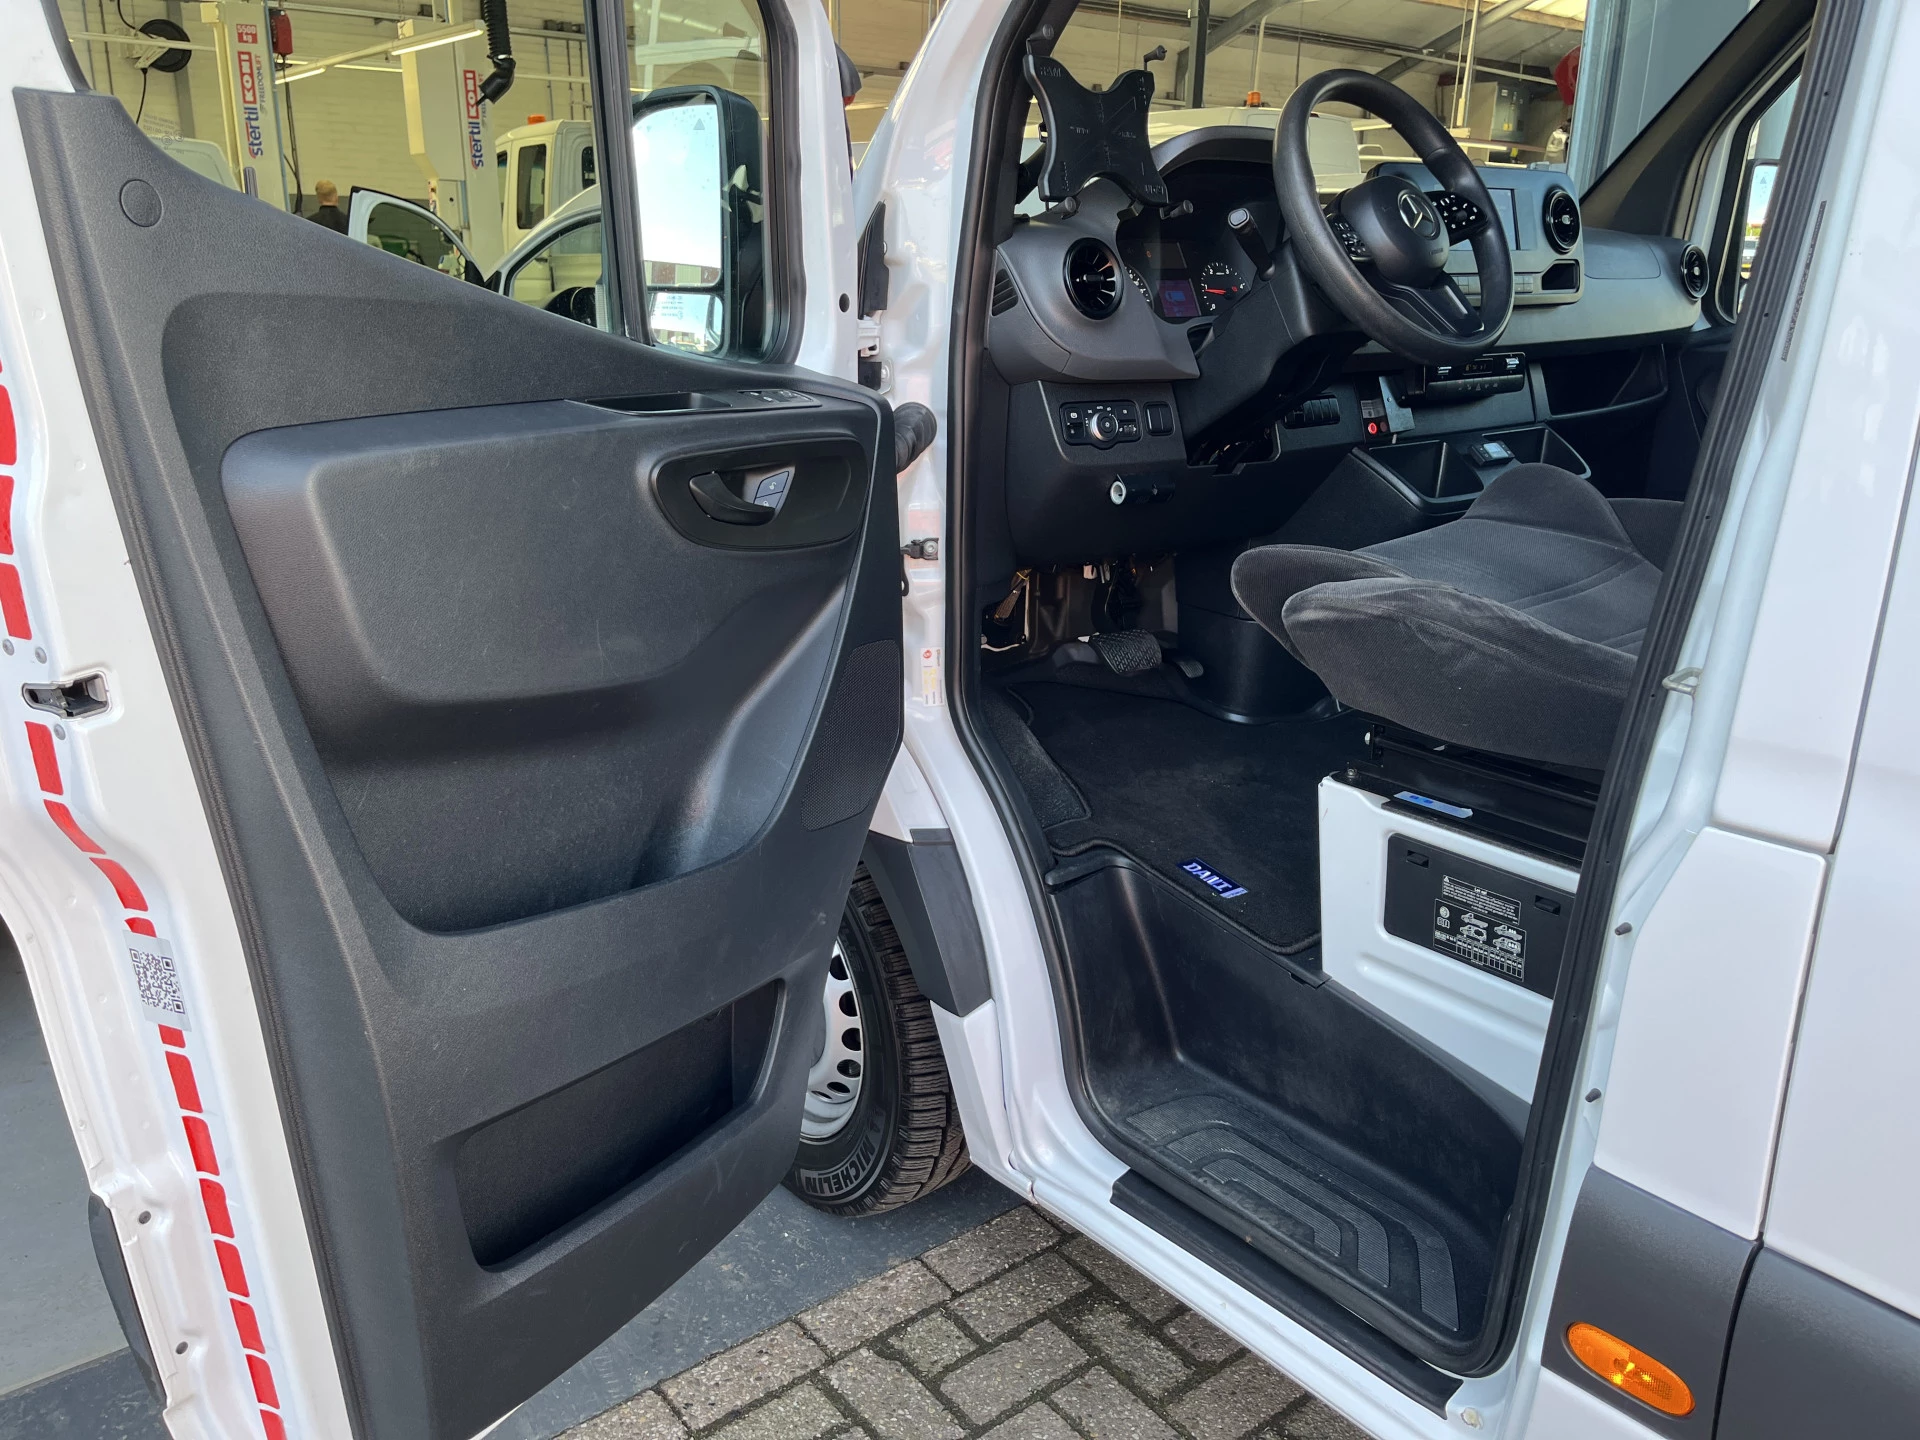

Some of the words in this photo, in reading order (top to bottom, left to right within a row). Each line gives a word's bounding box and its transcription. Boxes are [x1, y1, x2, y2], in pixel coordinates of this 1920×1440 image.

[237, 25, 256, 34] 5500
[242, 32, 253, 42] kg
[239, 52, 256, 103] KONI
[464, 71, 479, 118] KONI
[244, 106, 263, 158] stertil
[468, 121, 484, 169] stertil
[804, 1134, 877, 1194] MICHELIN
